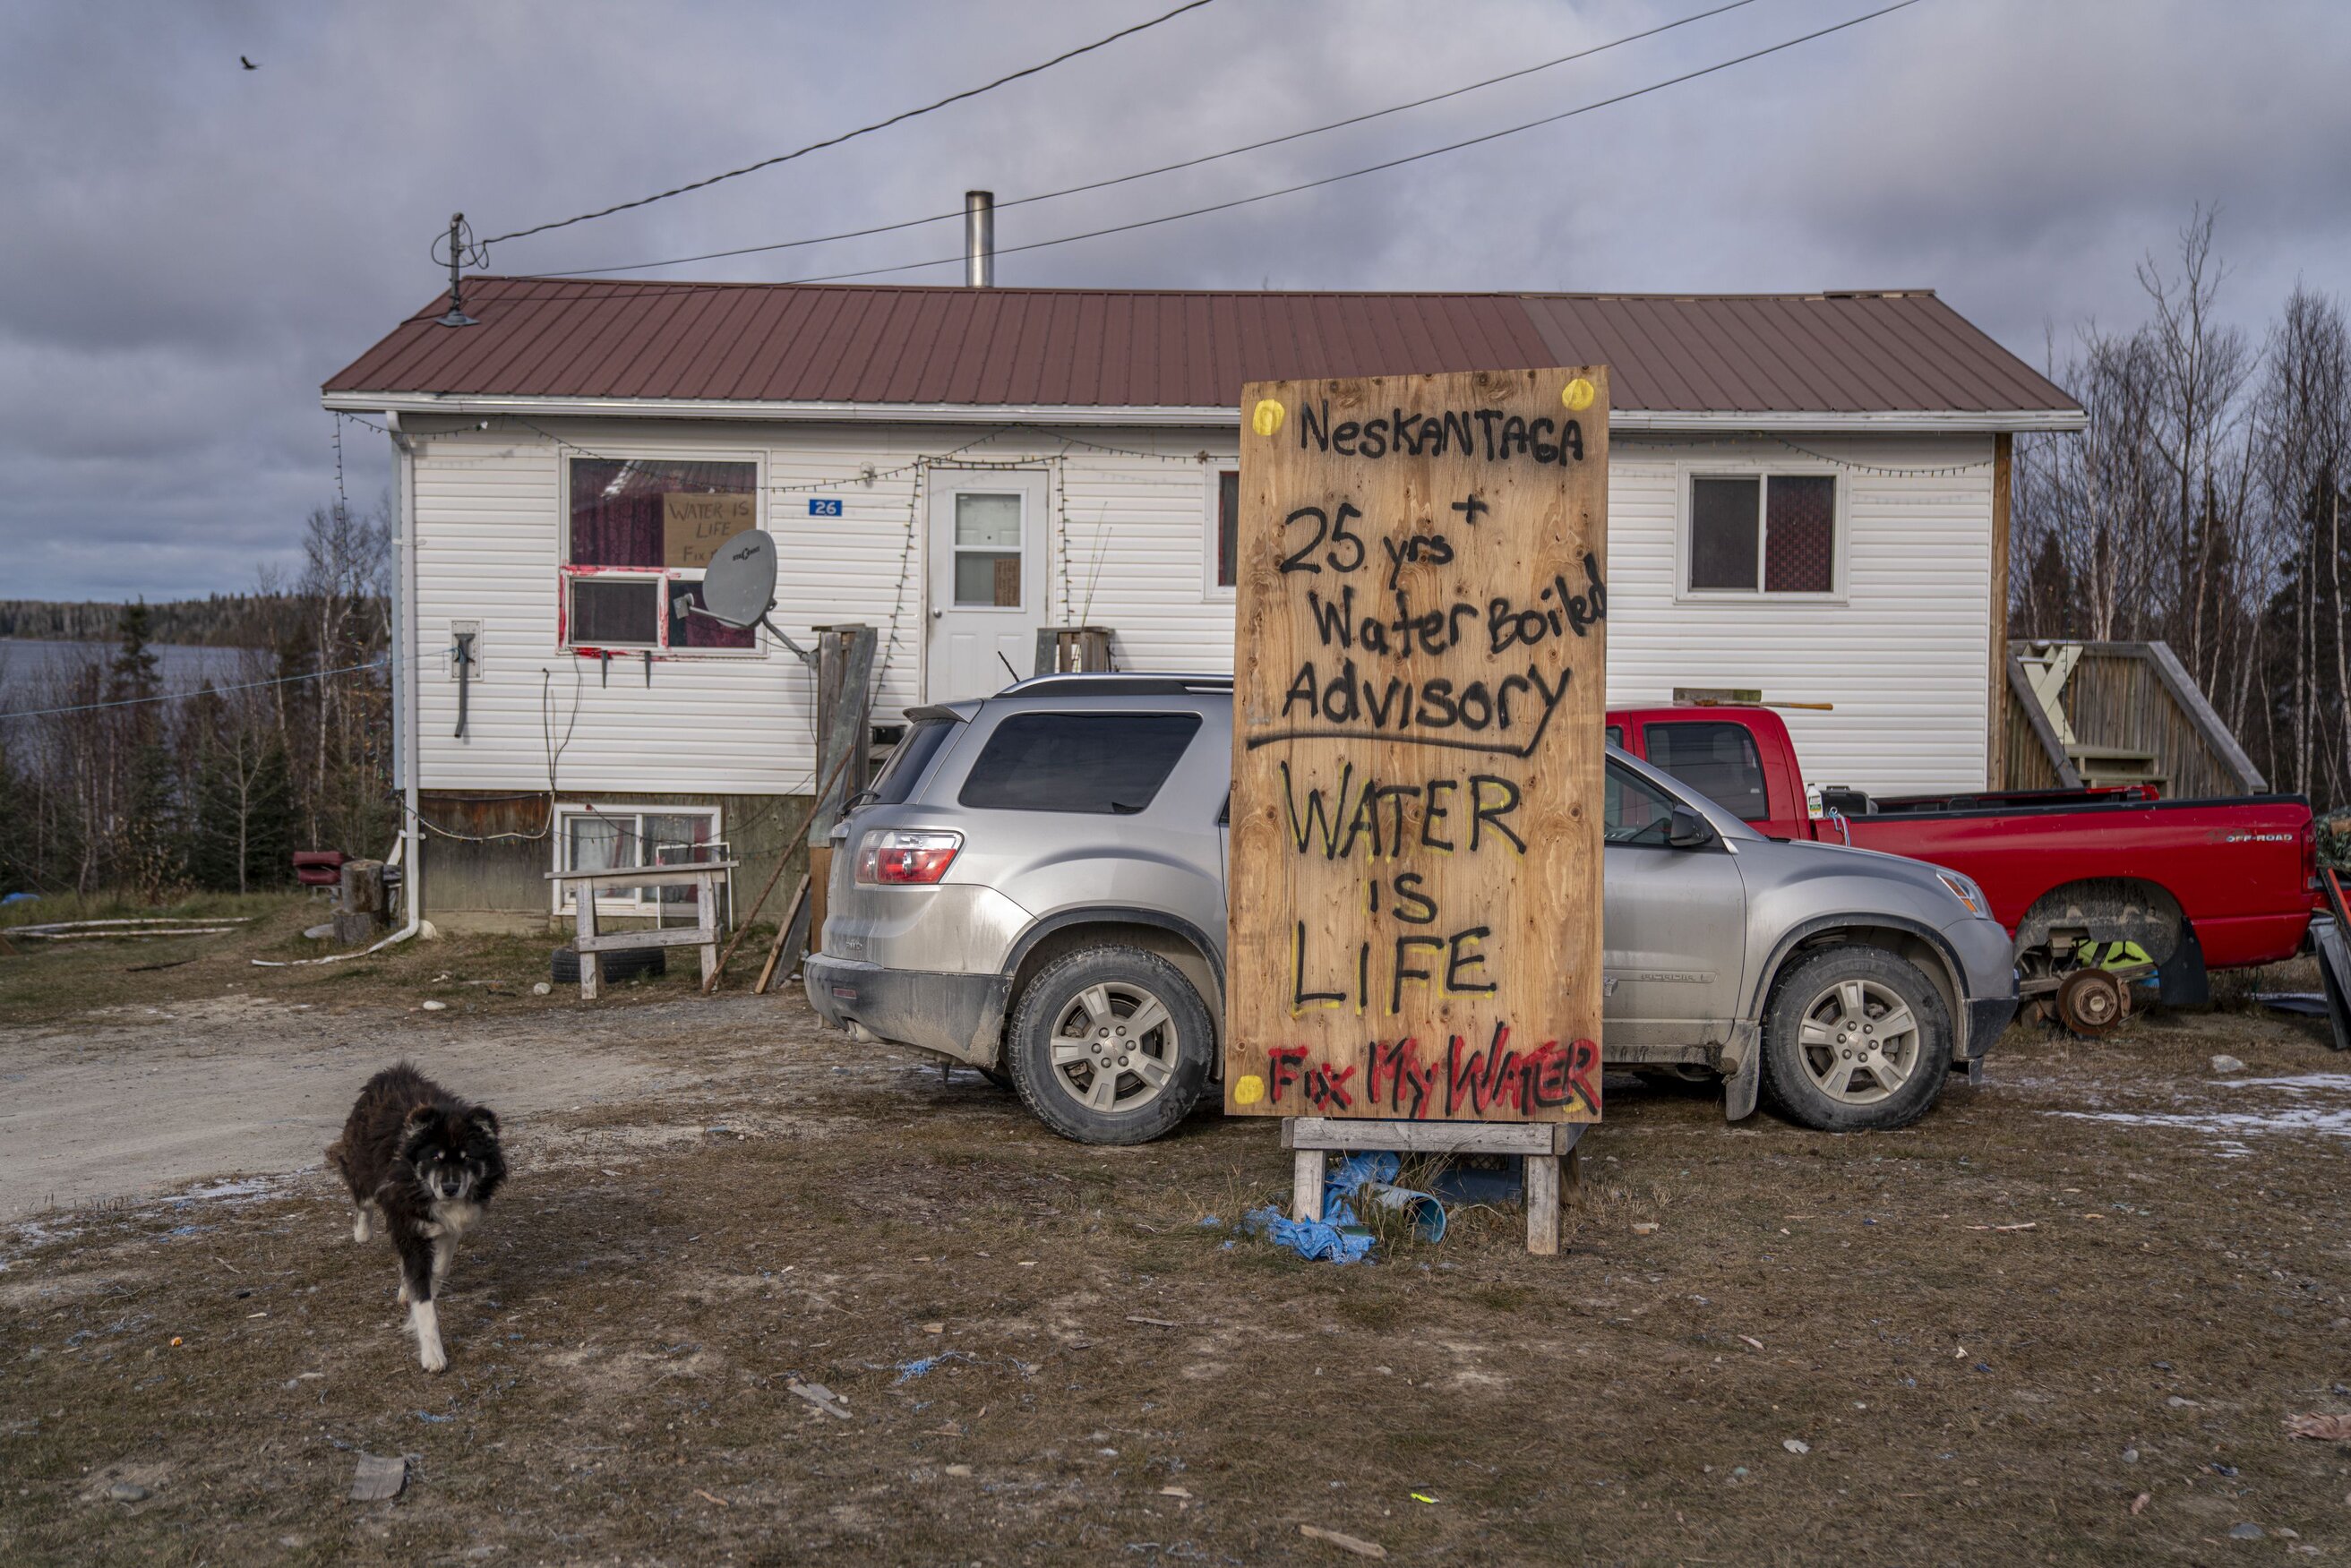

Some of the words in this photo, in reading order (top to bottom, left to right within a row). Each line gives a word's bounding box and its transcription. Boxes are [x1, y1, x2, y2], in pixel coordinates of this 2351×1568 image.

[669, 501, 723, 521] WATER
[733, 501, 749, 517] IS
[696, 521, 731, 539] LIFE
[815, 501, 837, 515] 26
[1280, 502, 1366, 576] 25
[1384, 534, 1455, 590] yrs
[1308, 584, 1480, 658] Water
[1281, 656, 1571, 754] Advisory
[1279, 760, 1526, 862] WATER
[2226, 834, 2293, 843] OFF-ROAD
[1291, 920, 1497, 1016] LIFE
